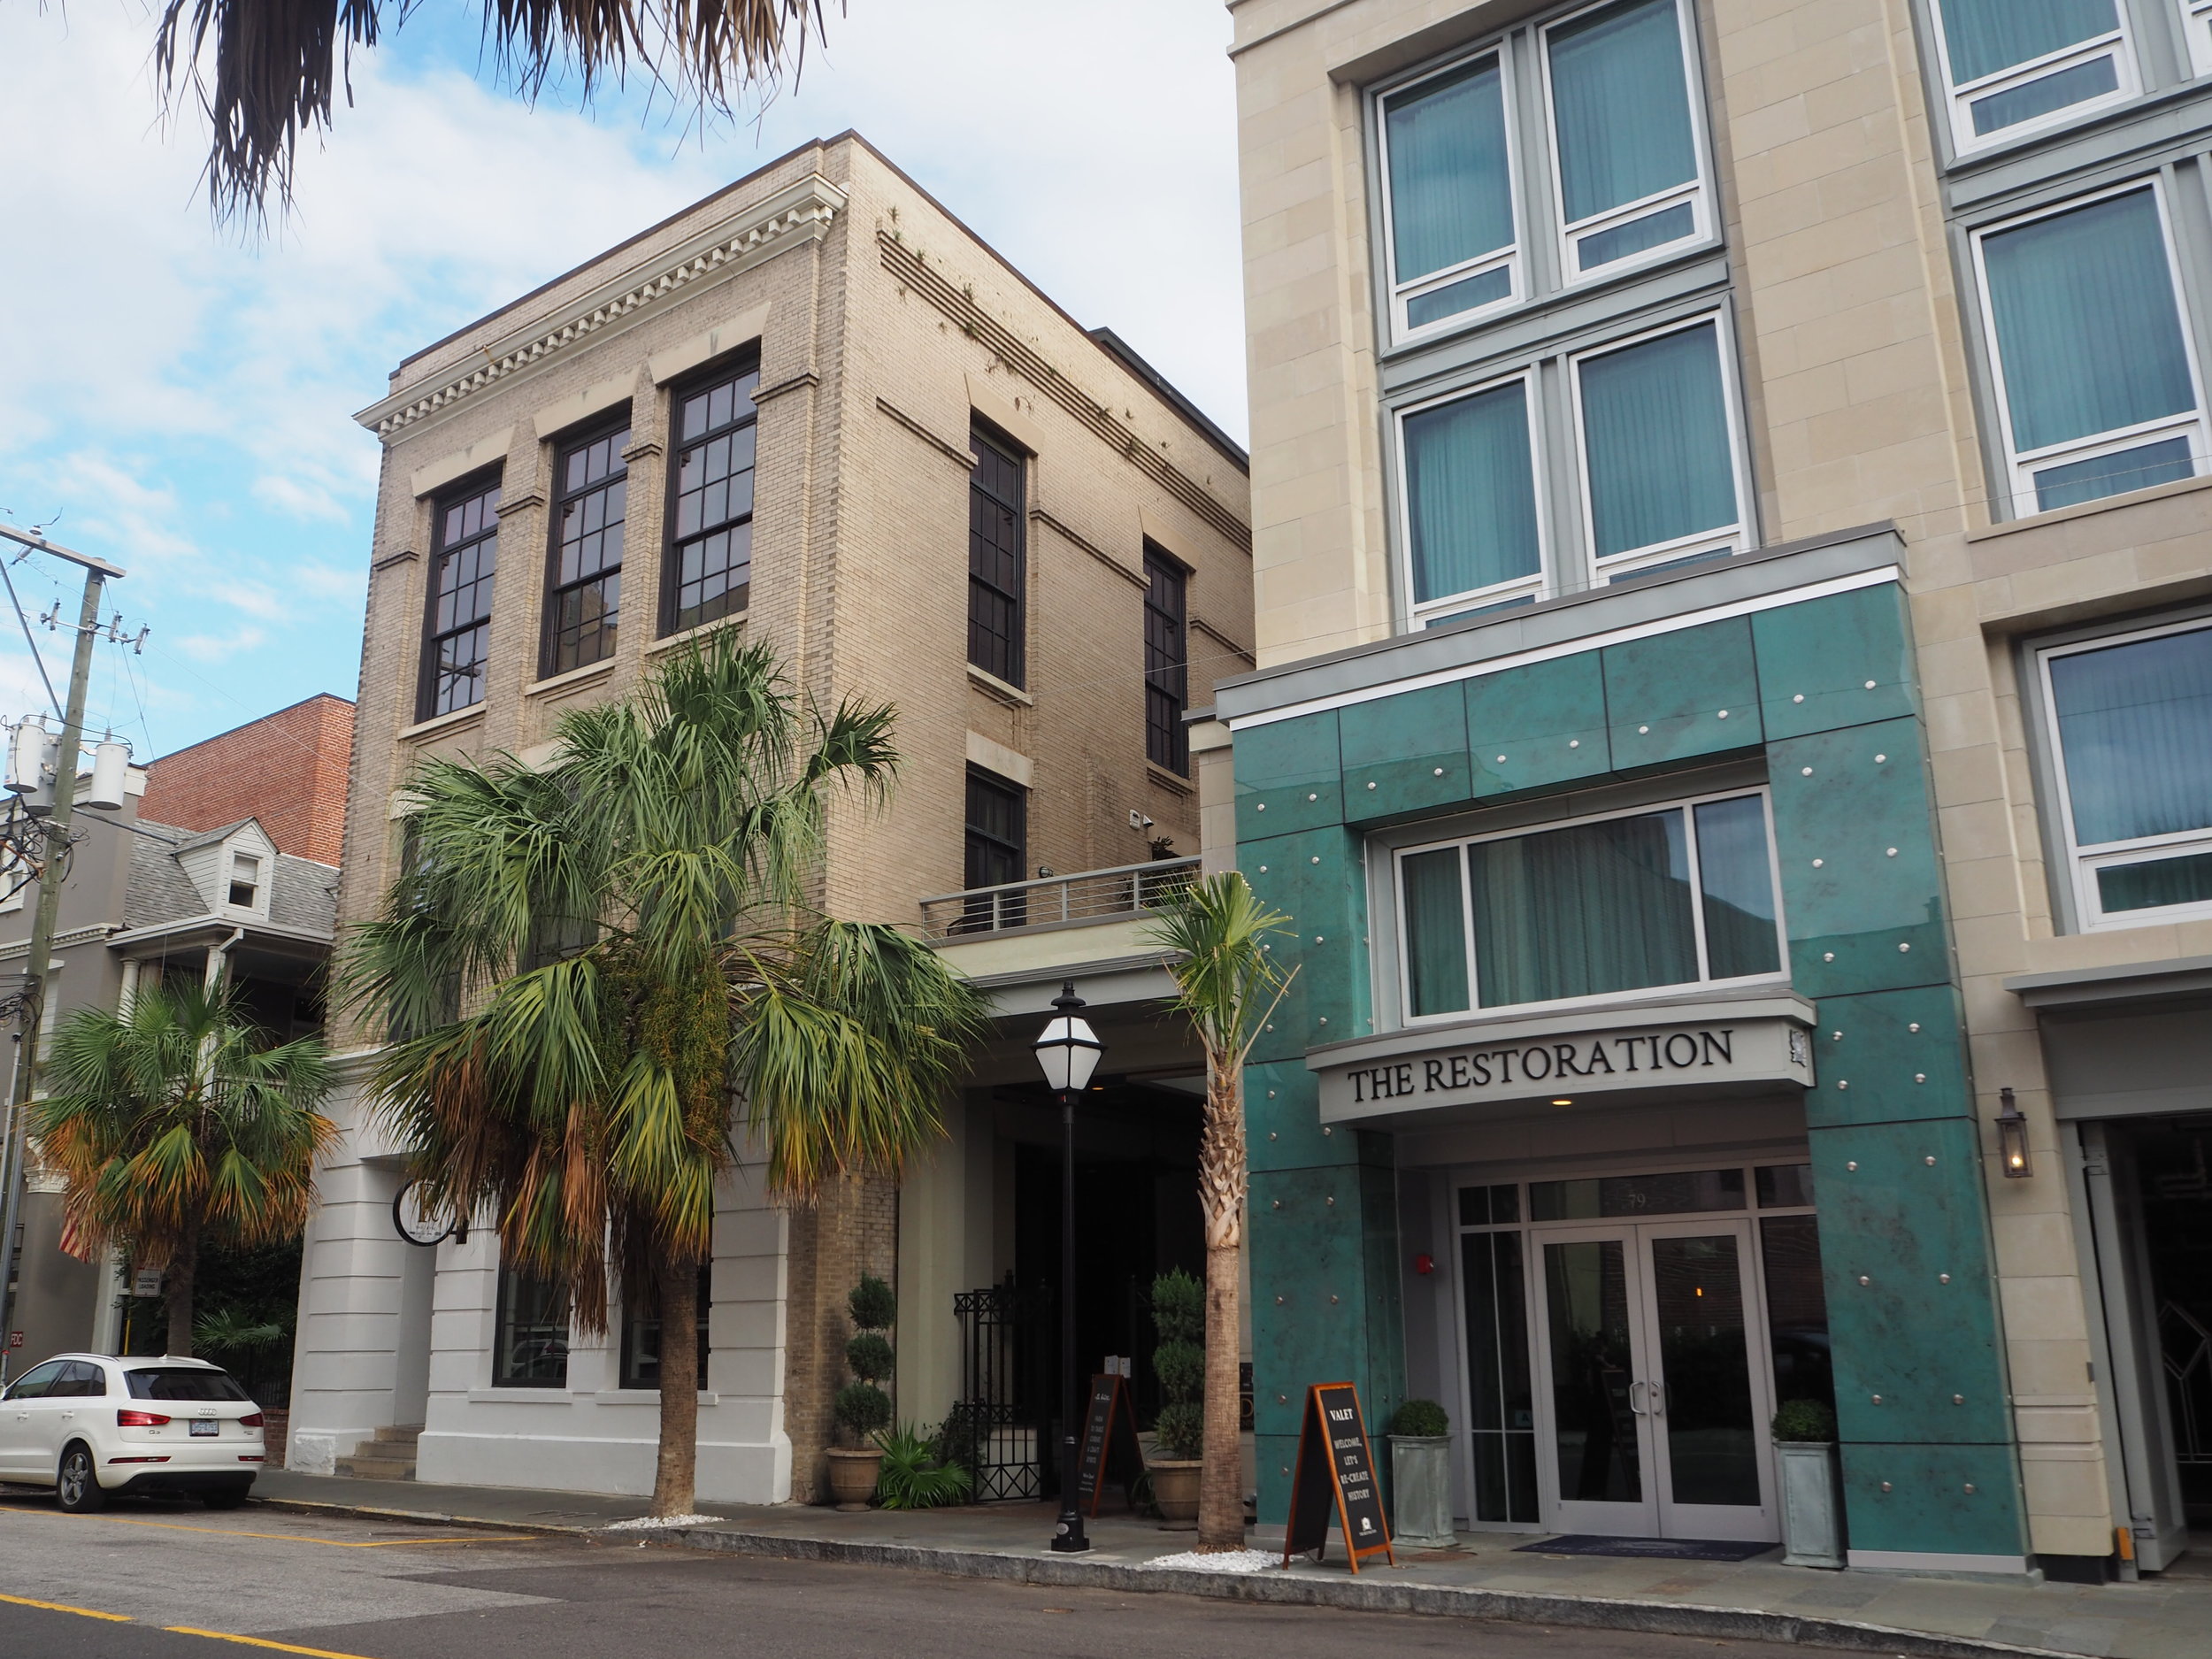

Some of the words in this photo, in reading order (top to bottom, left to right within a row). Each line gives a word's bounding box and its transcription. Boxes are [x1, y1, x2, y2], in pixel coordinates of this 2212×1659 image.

[1348, 1063, 1415, 1102] THE
[1423, 1029, 1733, 1092] RESTORATION
[1628, 1193, 1646, 1209] 79
[11, 1333, 23, 1345] FDC
[1329, 1408, 1354, 1422] VALET
[1343, 1455, 1359, 1466] LET'S
[1340, 1471, 1370, 1485] RE-CREATE
[1347, 1488, 1371, 1502] HISTORY
